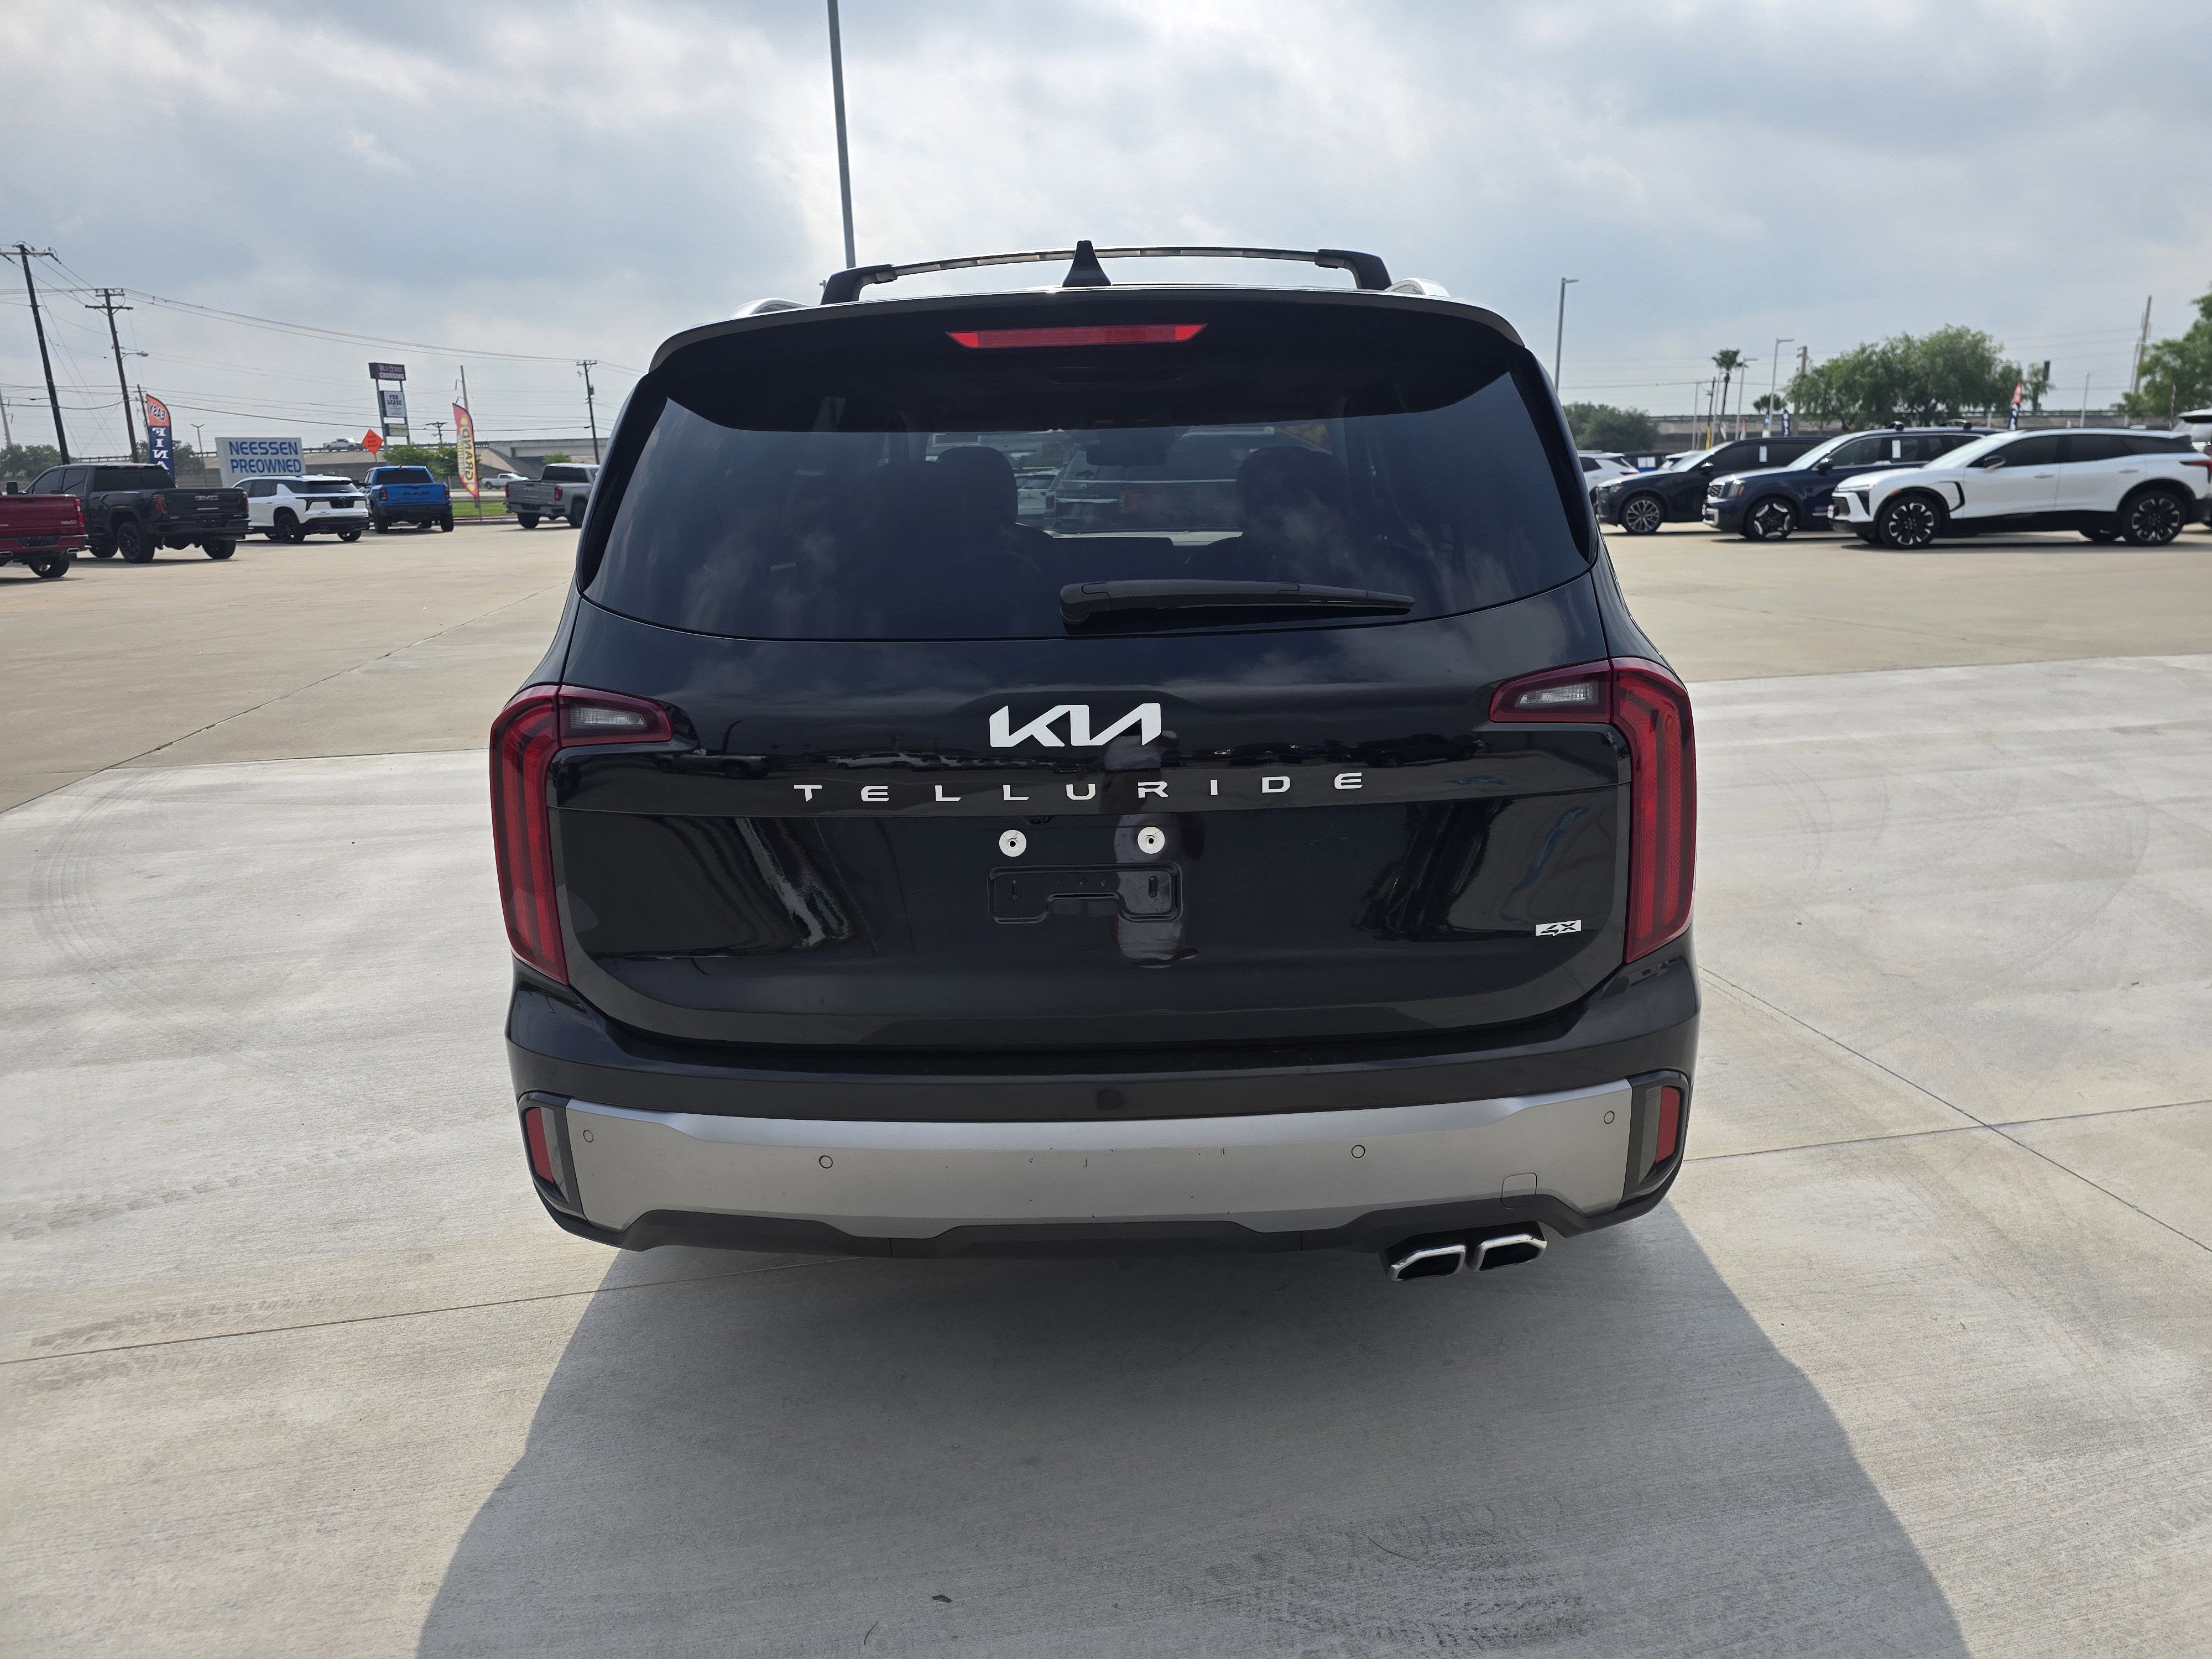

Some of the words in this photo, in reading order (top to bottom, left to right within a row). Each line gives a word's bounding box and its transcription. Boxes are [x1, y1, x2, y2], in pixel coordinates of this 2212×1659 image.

[228, 441, 299, 455] NEESSEN
[230, 458, 301, 473] PREOWNED
[989, 702, 1161, 748] KIA
[794, 772, 1364, 802] TELLURIDE
